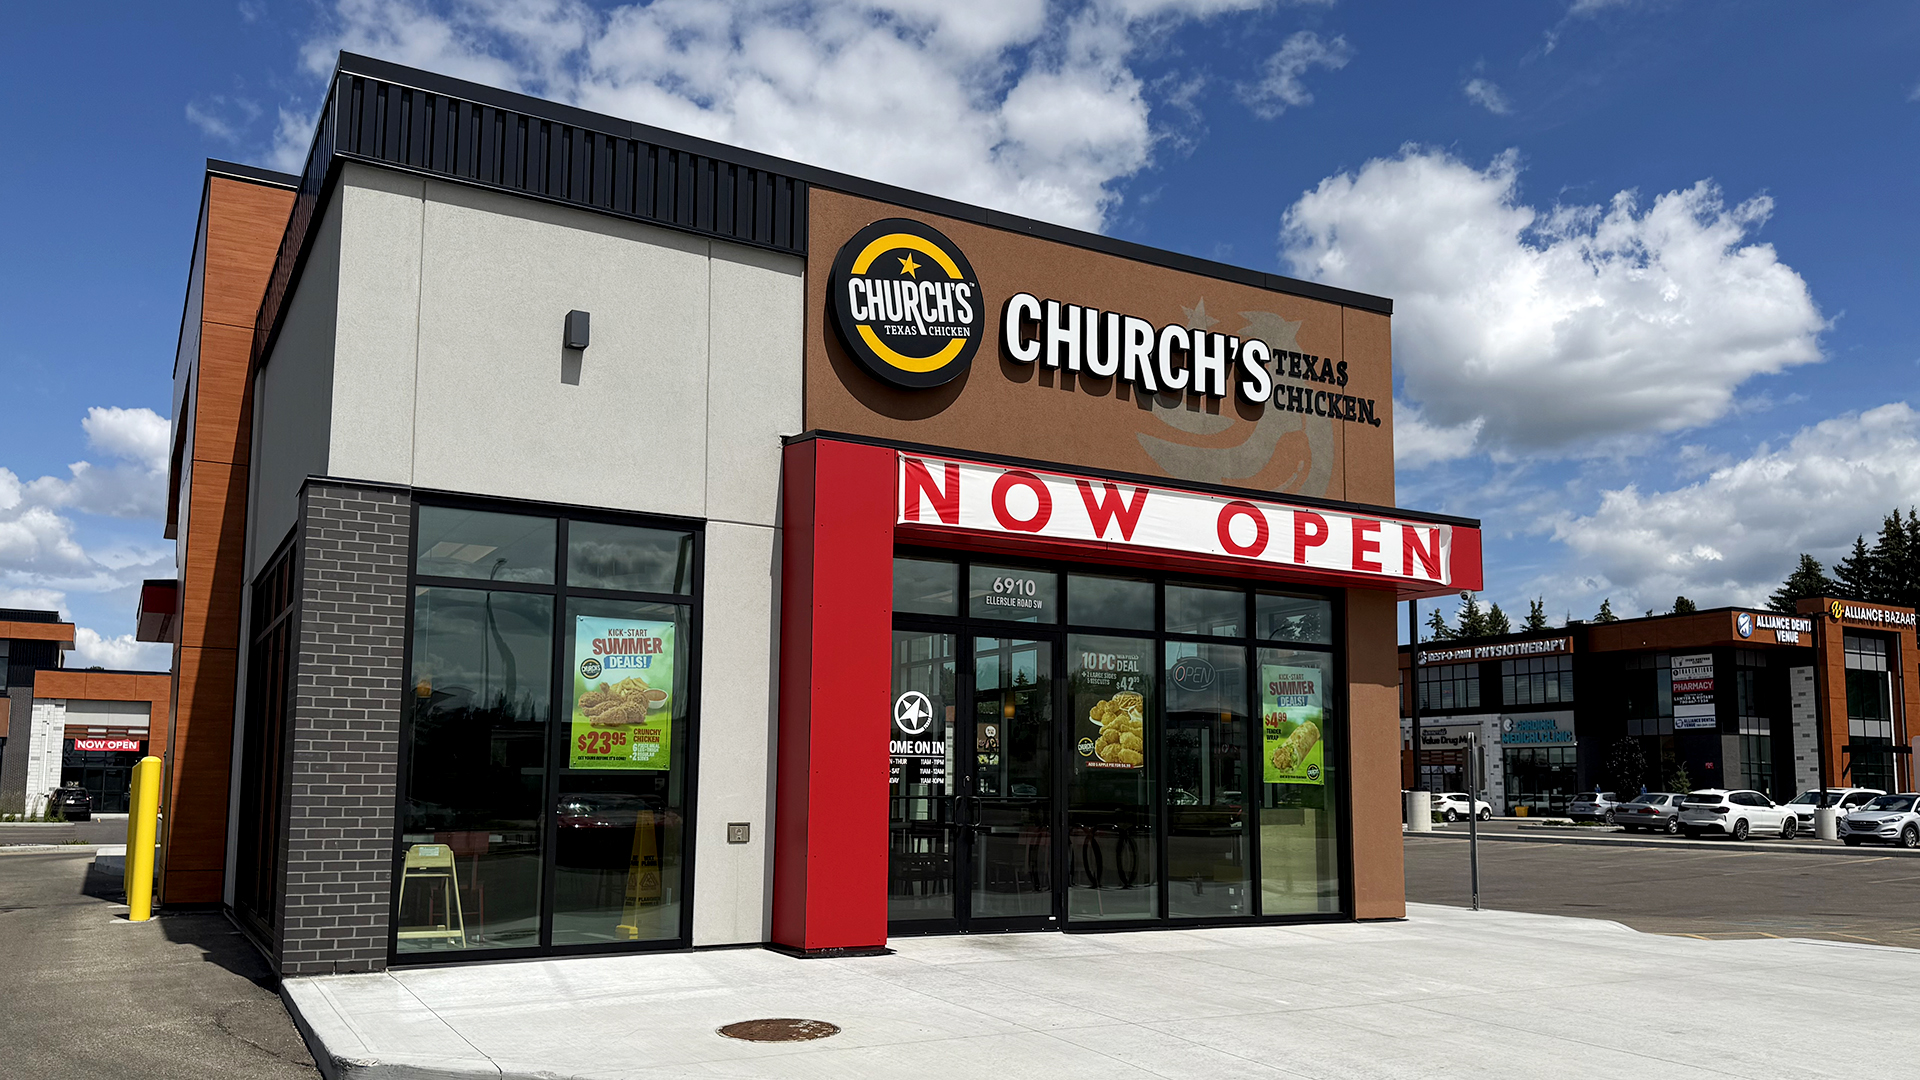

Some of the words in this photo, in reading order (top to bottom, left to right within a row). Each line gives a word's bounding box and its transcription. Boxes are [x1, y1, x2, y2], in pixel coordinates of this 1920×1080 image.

[848, 277, 974, 336] CHURCH'S
[884, 325, 917, 336] TEXAS
[928, 326, 970, 336] CHICKEN
[1005, 291, 1272, 403] CHURCH'S
[1273, 348, 1348, 387] TEXAS
[904, 457, 1149, 542] NOW
[1217, 500, 1441, 580] OPEN
[993, 577, 1036, 596] 6910
[986, 596, 1016, 607] ELLERSLIE
[1017, 598, 1032, 608] ROAD
[1033, 600, 1042, 609] SW
[1844, 605, 1884, 622] ALLIANCE
[1884, 611, 1916, 626] BAZAAR
[1756, 616, 1790, 630] ALLIANCE
[608, 628, 648, 638] KICK-START
[1776, 630, 1800, 644] VENUE
[592, 638, 663, 656] SUMMER
[1474, 638, 1566, 659] PHYSIOTHERAPY
[610, 656, 647, 668] DEALS!
[1082, 652, 1097, 670] 10
[1098, 652, 1116, 670] PC
[1116, 660, 1139, 672] DEAL
[1176, 666, 1211, 683] OPEN
[1269, 681, 1314, 695] SUMMER
[1673, 681, 1713, 692] PHARMACY
[1281, 696, 1305, 706] DEALS!
[1516, 719, 1557, 731] CARDINAL
[77, 740, 105, 749] NOW
[107, 741, 137, 749] OPEN
[1421, 736, 1440, 744] Value
[1441, 736, 1458, 746] Drug
[1459, 735, 1477, 744] Mt
[1502, 731, 1541, 744] MEDICAL
[1542, 731, 1573, 742] CLINIC
[633, 743, 637, 752] 6
[890, 740, 913, 754] OME
[915, 741, 930, 754] ON
[932, 741, 944, 754] IN
